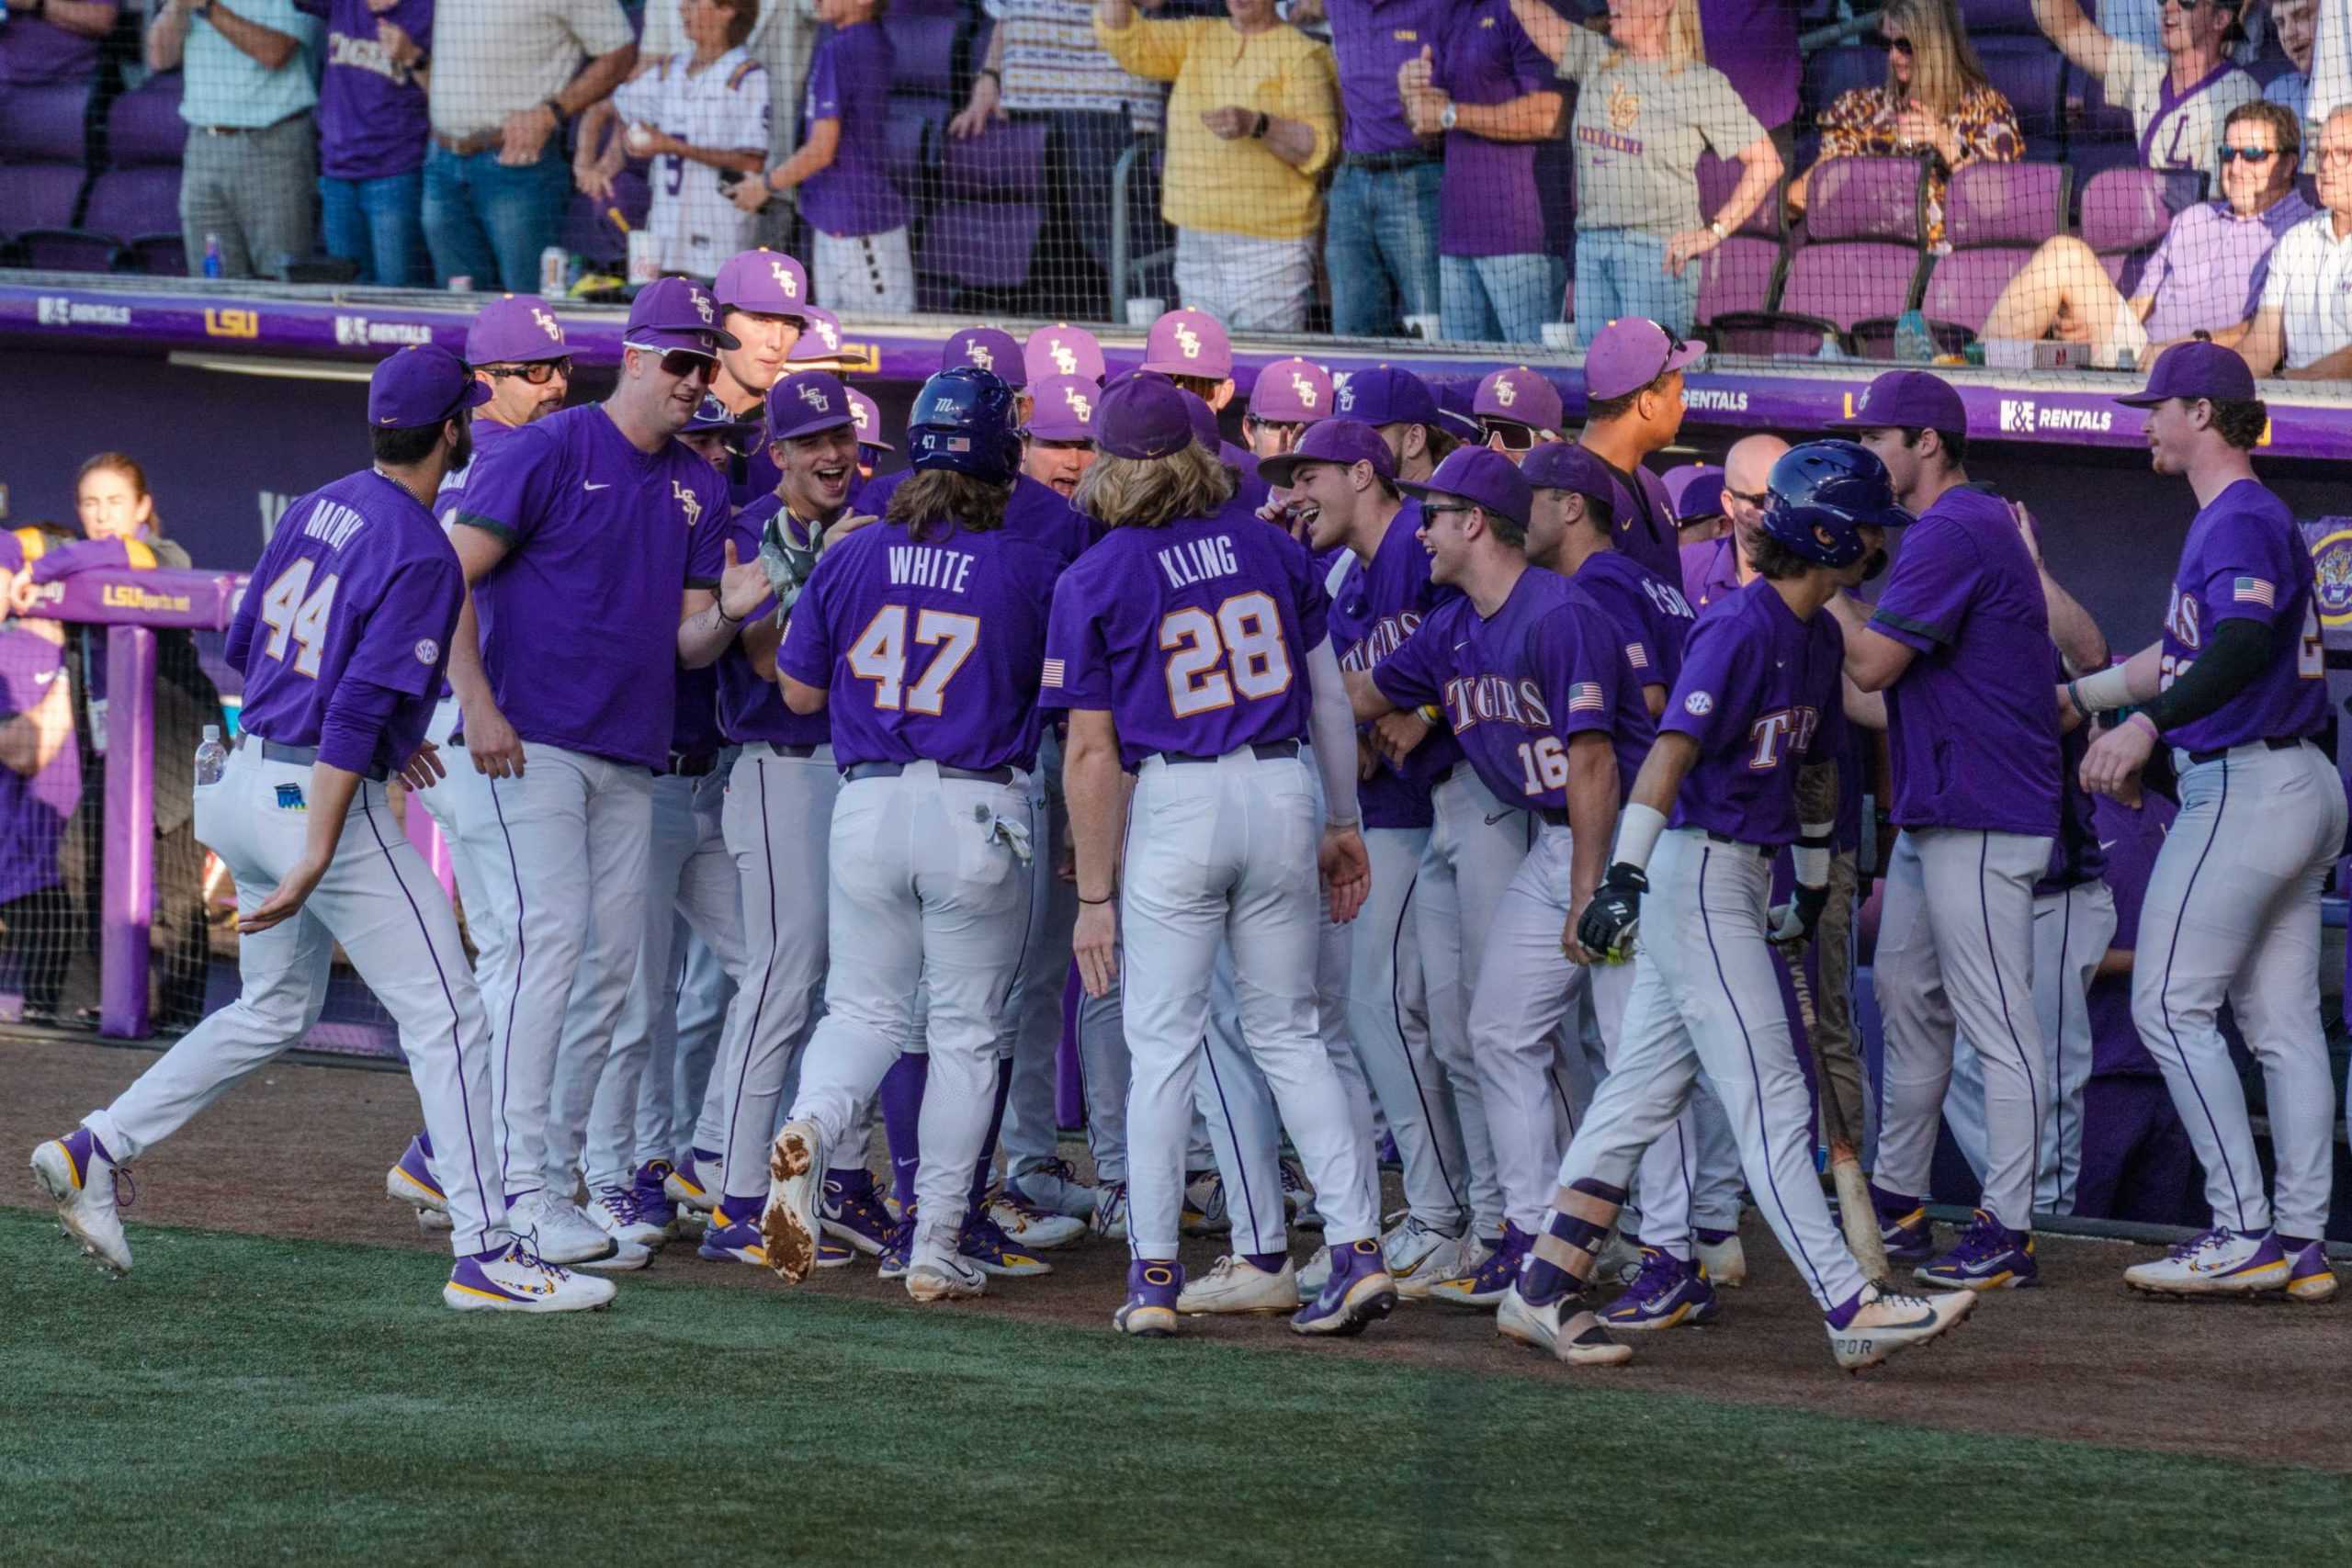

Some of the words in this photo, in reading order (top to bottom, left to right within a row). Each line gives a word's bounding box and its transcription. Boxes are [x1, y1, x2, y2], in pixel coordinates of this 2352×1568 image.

[771, 262, 797, 298] LSU
[691, 288, 714, 323] LSU
[205, 309, 258, 338] LSU
[531, 309, 560, 340] LSU
[815, 319, 837, 351] LSU
[1175, 322, 1201, 358] LSU
[1051, 340, 1078, 375] LSU
[797, 383, 829, 412] LSU
[1066, 387, 1092, 423] LSU
[1292, 373, 1317, 407] LSU
[1493, 375, 1518, 407] LSU
[2039, 408, 2112, 431] RENTALS
[922, 435, 935, 449] 47
[672, 480, 702, 526] LSU
[888, 547, 975, 593] WHITE
[1159, 536, 1238, 589] KLING
[262, 557, 339, 680] 44
[846, 604, 980, 716] 47
[1159, 590, 1293, 718] 28
[1518, 735, 1568, 795] 16
